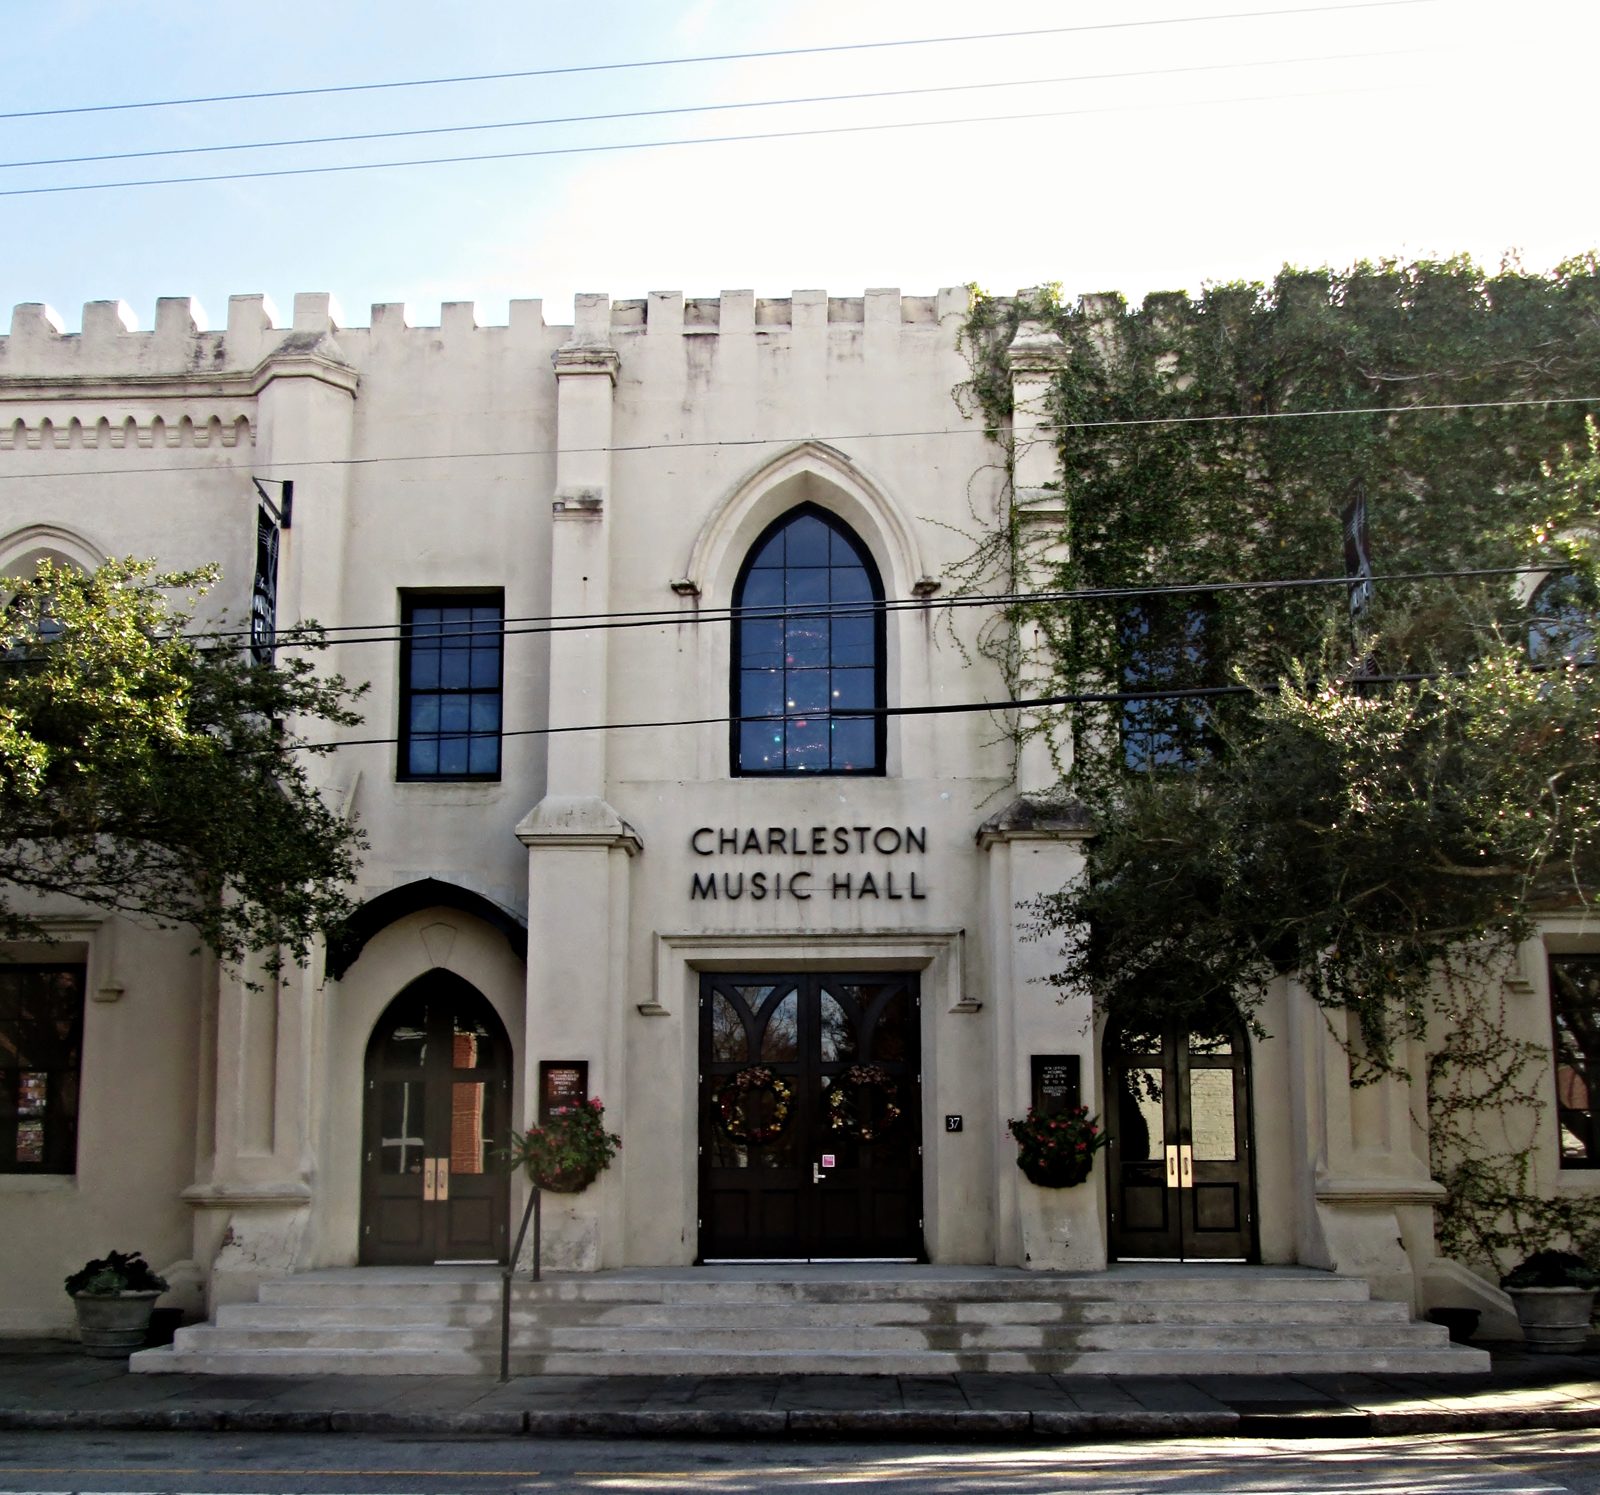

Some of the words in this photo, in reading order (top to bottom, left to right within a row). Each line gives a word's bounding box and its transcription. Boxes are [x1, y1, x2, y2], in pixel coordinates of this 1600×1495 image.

[691, 827, 926, 856] CHARLESTON
[691, 872, 812, 900] MUSIC
[832, 872, 926, 900] HALL
[948, 1117, 960, 1129] 37
